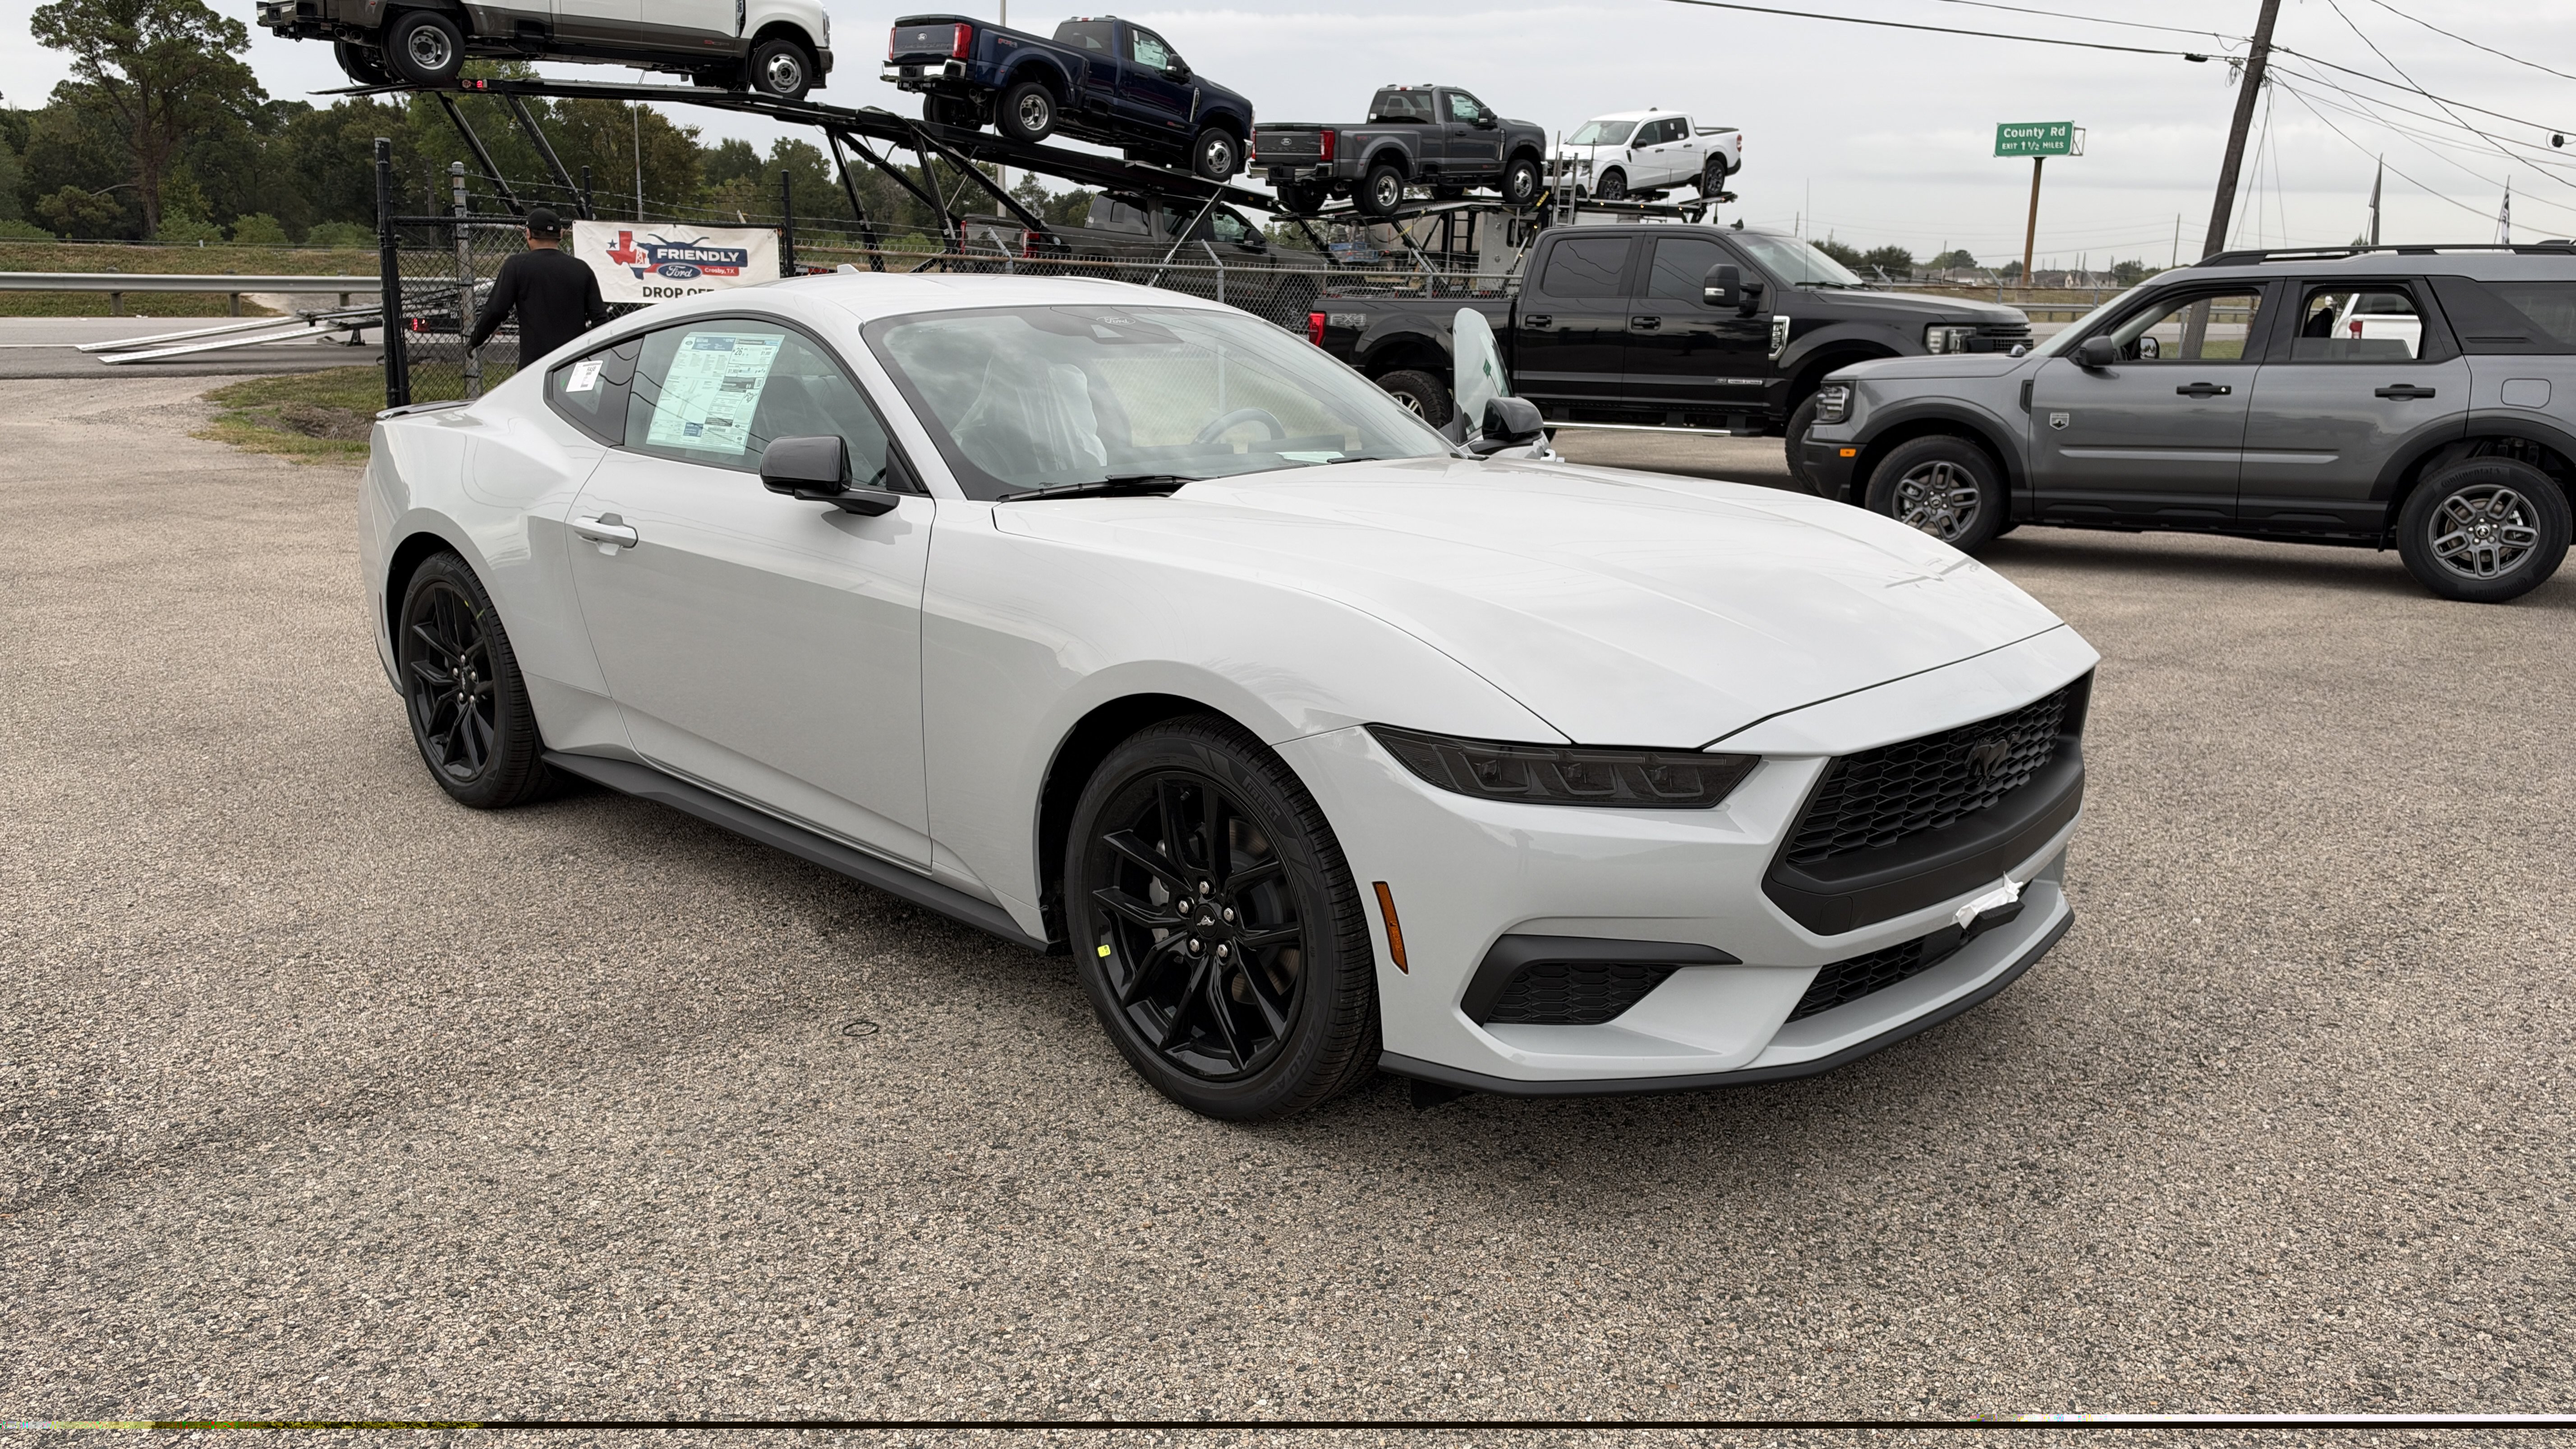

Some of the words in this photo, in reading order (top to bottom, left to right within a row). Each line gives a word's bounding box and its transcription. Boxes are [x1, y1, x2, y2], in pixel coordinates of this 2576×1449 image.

[2004, 127, 2044, 139] County
[2050, 126, 2065, 136] Rd
[657, 248, 739, 262] FRIENDLY
[666, 265, 693, 277] Ford
[643, 286, 683, 299] DROP
[1329, 313, 1366, 327] FX4
[734, 347, 744, 355] 26
[1242, 775, 1281, 821] PIRELLI
